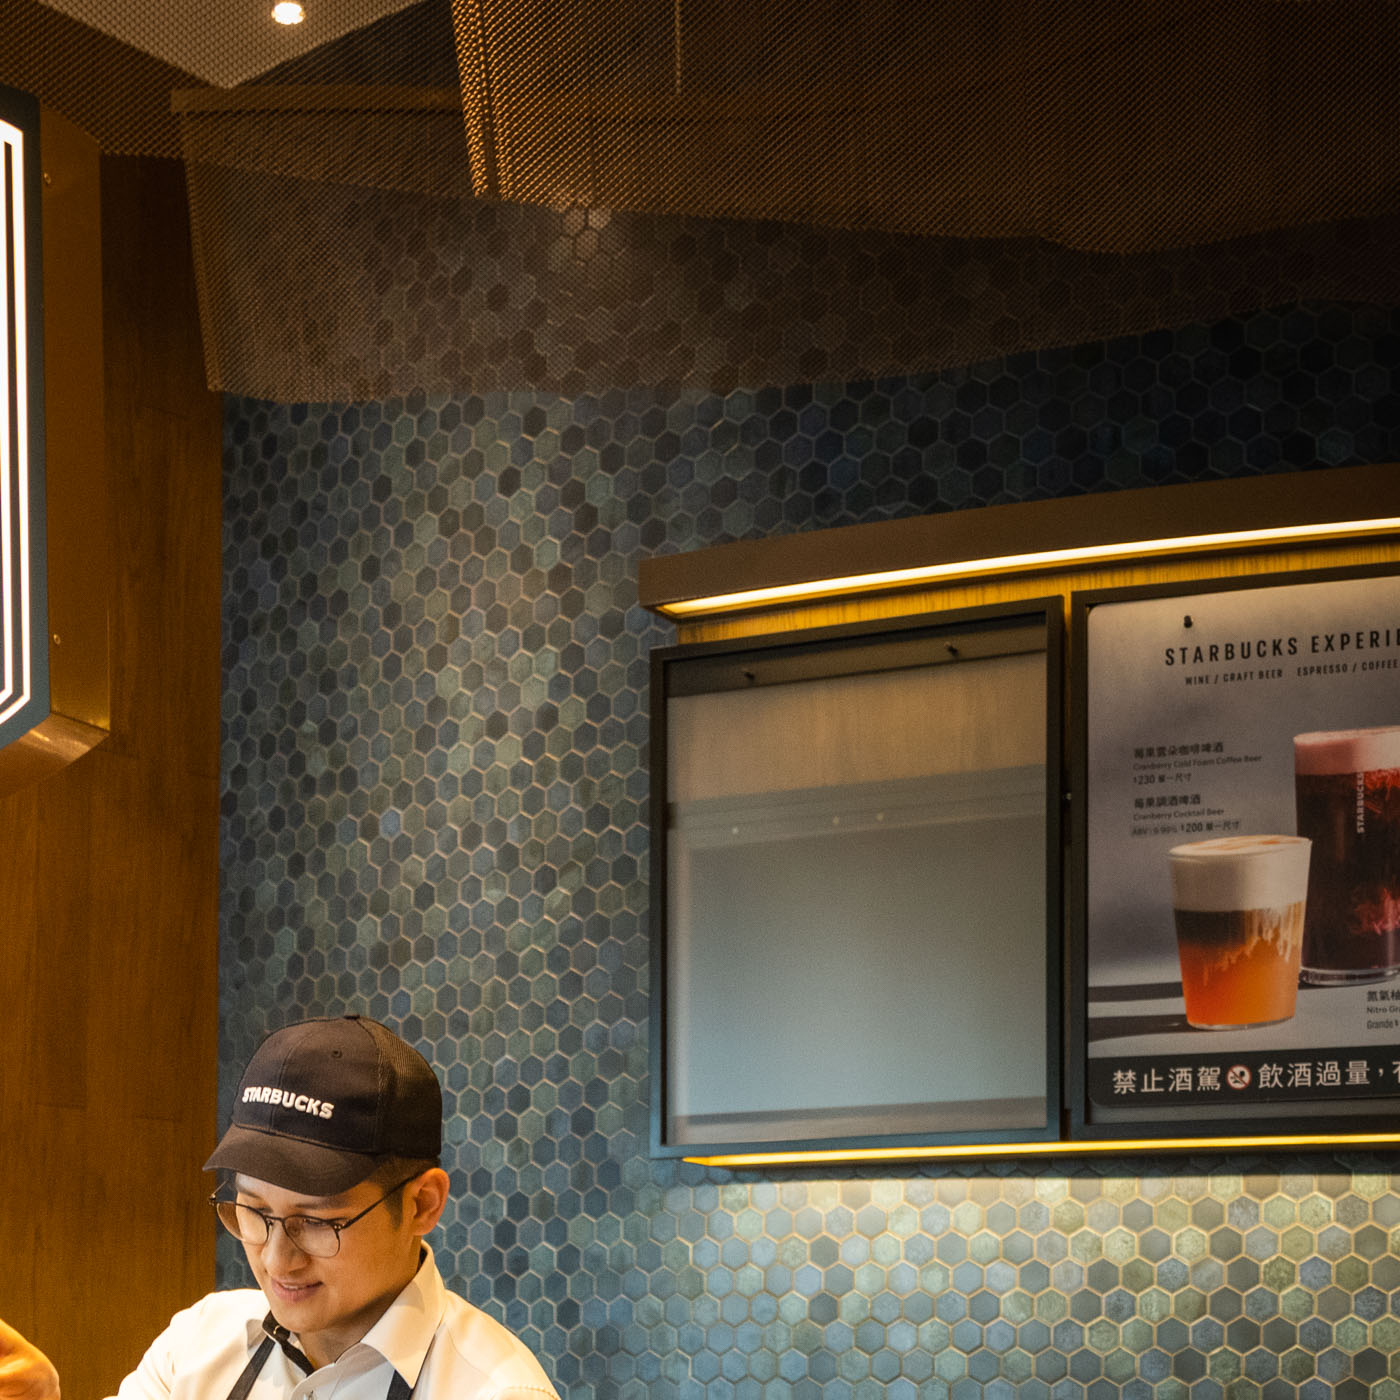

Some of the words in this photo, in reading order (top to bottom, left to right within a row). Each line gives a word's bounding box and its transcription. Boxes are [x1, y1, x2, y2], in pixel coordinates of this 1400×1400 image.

[1164, 637, 1299, 667] STARBUCKS
[1185, 674, 1210, 686] WINE
[1223, 671, 1256, 683] CRAFT
[1258, 669, 1283, 680] BEER
[1297, 663, 1349, 678] ESPRESSO
[1361, 659, 1399, 672] COFFEE
[1367, 1006, 1387, 1014] Nitro
[1112, 1066, 1222, 1095] 禁止酒駕
[242, 1086, 335, 1119] STARBUCKS
